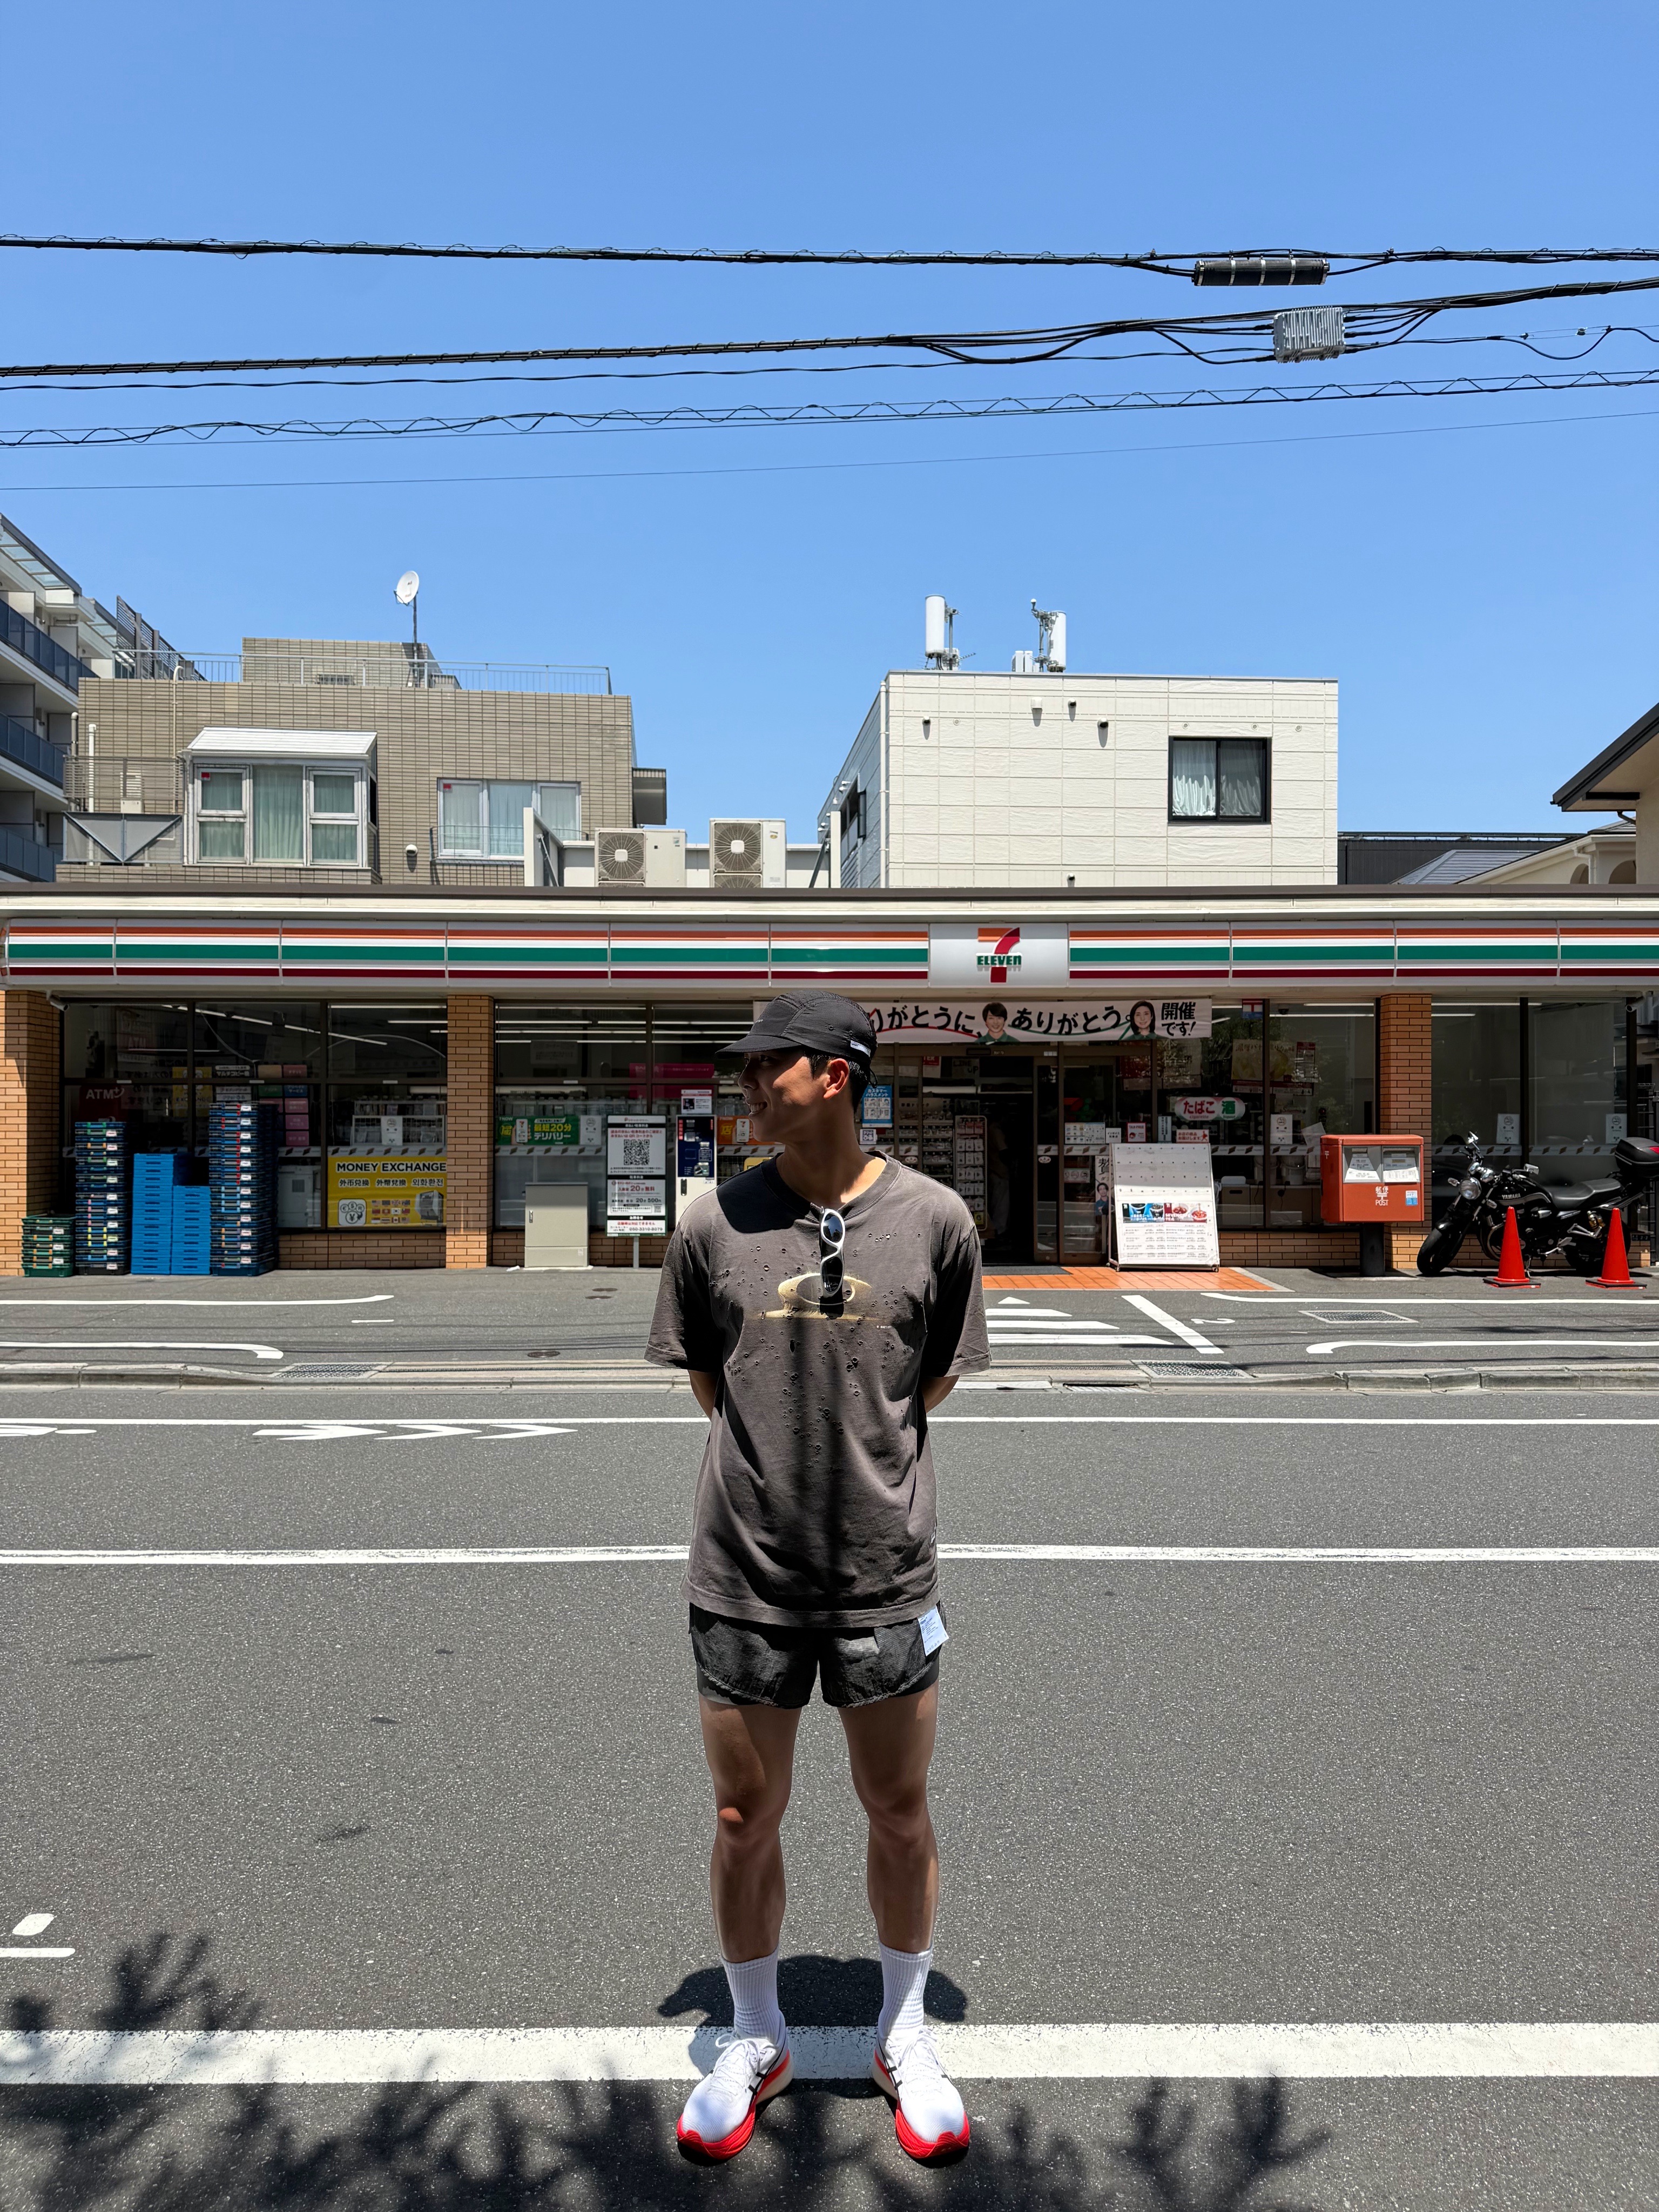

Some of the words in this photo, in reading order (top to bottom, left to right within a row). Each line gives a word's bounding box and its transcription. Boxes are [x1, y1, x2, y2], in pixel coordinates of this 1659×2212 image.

[1161, 1002, 1196, 1020] 開催
[1183, 1100, 1215, 1114] たばこ
[1222, 1100, 1236, 1114] 酒
[534, 1132, 571, 1141] デリバリー
[337, 1163, 379, 1172] MONEY
[382, 1162, 447, 1172] EXCHANGE
[412, 1178, 444, 1187] 외화환전
